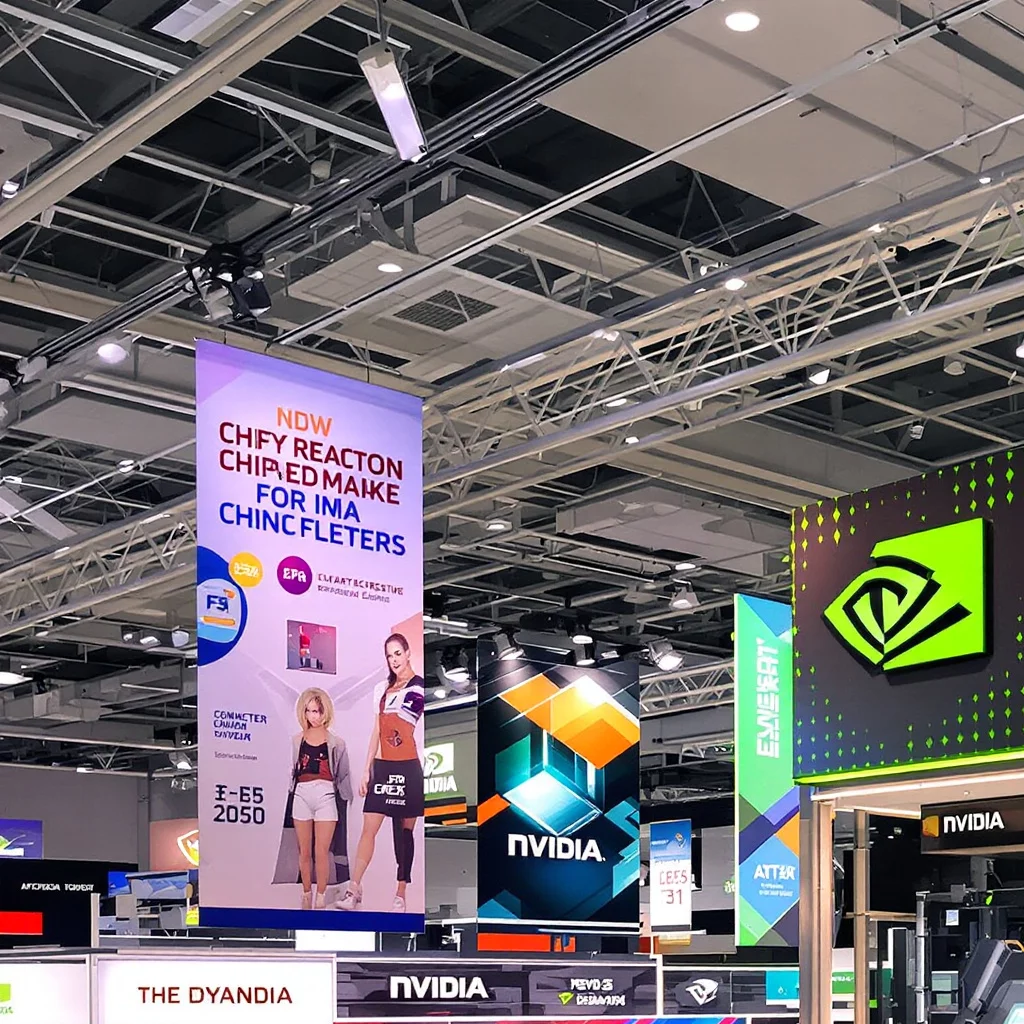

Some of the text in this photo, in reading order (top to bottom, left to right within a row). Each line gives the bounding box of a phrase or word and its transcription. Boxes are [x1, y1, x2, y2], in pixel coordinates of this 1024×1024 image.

[294, 437, 403, 480] REACTON
[257, 483, 306, 513] FOR
[219, 502, 406, 556] CHINC FLETERS
[213, 804, 265, 825] 2050
[943, 811, 1005, 833] NVIDIA
[138, 986, 293, 1004] THE DYANDIA
[390, 976, 488, 999] NVIDIA
